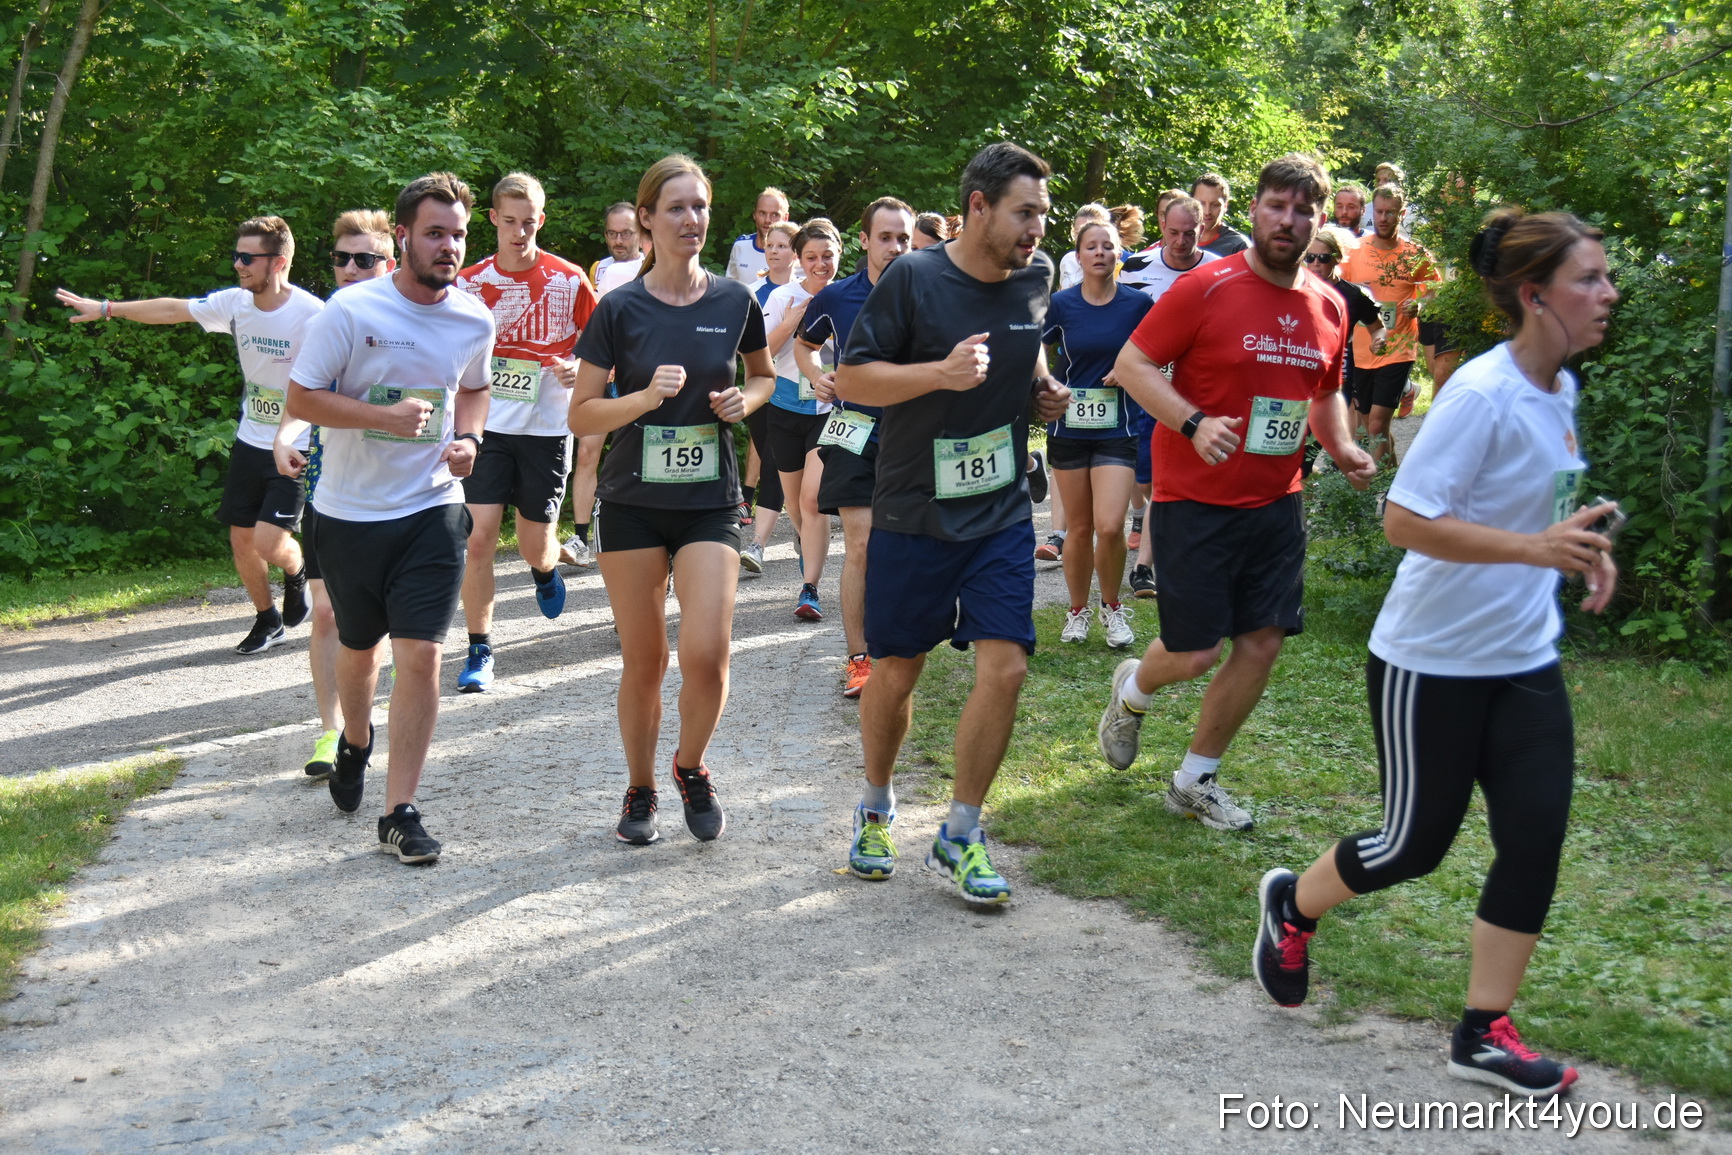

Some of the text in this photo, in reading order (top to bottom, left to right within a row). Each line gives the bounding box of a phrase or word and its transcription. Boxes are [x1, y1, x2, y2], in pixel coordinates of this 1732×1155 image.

[252, 336, 290, 349] HAUBNER
[257, 346, 285, 356] TREPPEN
[1243, 334, 1278, 351] Echtes
[1257, 353, 1318, 370] IMMER FRISCH
[492, 371, 532, 391] 2222
[251, 397, 280, 416] 1009
[1077, 402, 1107, 418] 819
[827, 419, 858, 439] 807
[1265, 419, 1301, 440] 588
[662, 446, 704, 467] 159
[955, 453, 996, 481] 181
[955, 474, 1000, 488] Weikert Tobias
